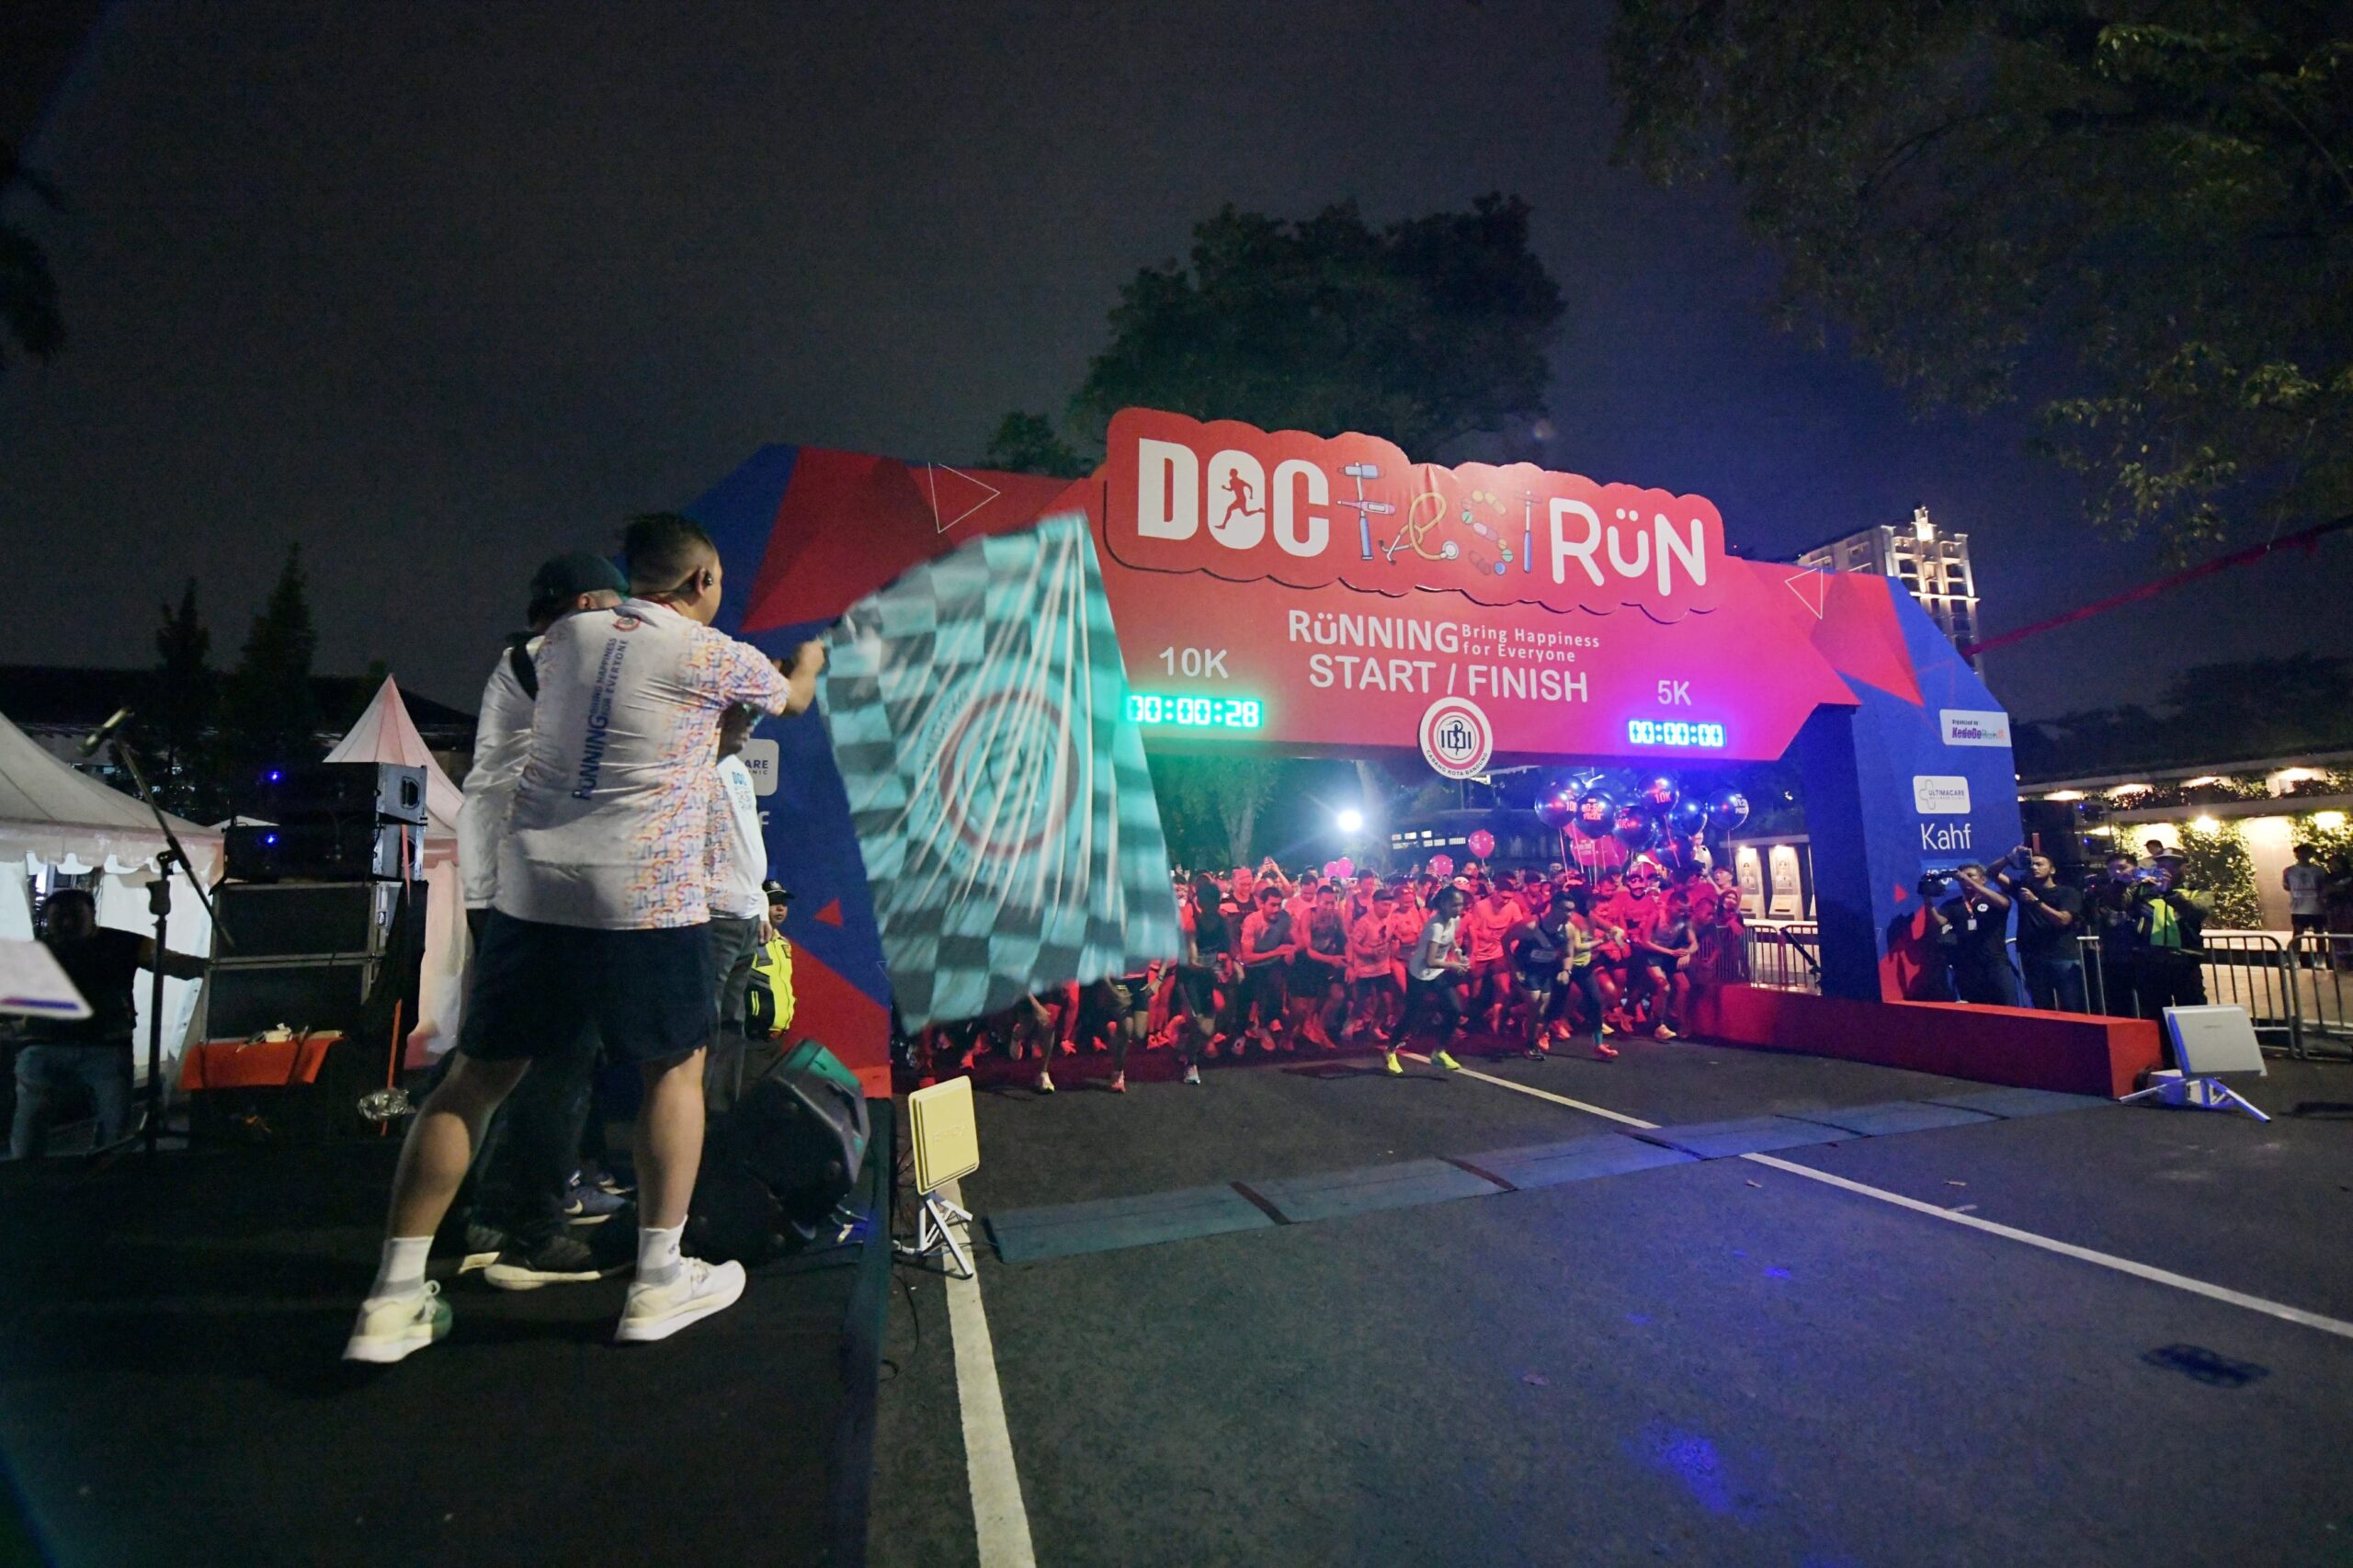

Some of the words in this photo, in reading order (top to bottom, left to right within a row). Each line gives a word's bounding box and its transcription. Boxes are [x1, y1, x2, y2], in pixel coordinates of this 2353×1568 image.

[1461, 624, 1507, 642] Bring
[1515, 628, 1600, 648] Happiness
[1159, 646, 1230, 678] 10K
[1463, 641, 1491, 655] for
[1497, 643, 1576, 663] Everyone
[605, 639, 629, 693] EVERYONE
[1309, 653, 1437, 694] START
[1447, 663, 1457, 696] /
[1468, 665, 1588, 702] FINISH
[1657, 679, 1692, 706] 5K
[1628, 720, 1724, 747] 00:00:00
[1427, 749, 1447, 772] CABANG
[1448, 768, 1464, 777] KOTA
[1465, 752, 1488, 776] BANDUNG
[1654, 791, 1672, 804] 10K
[1920, 823, 1972, 850] Kahf
